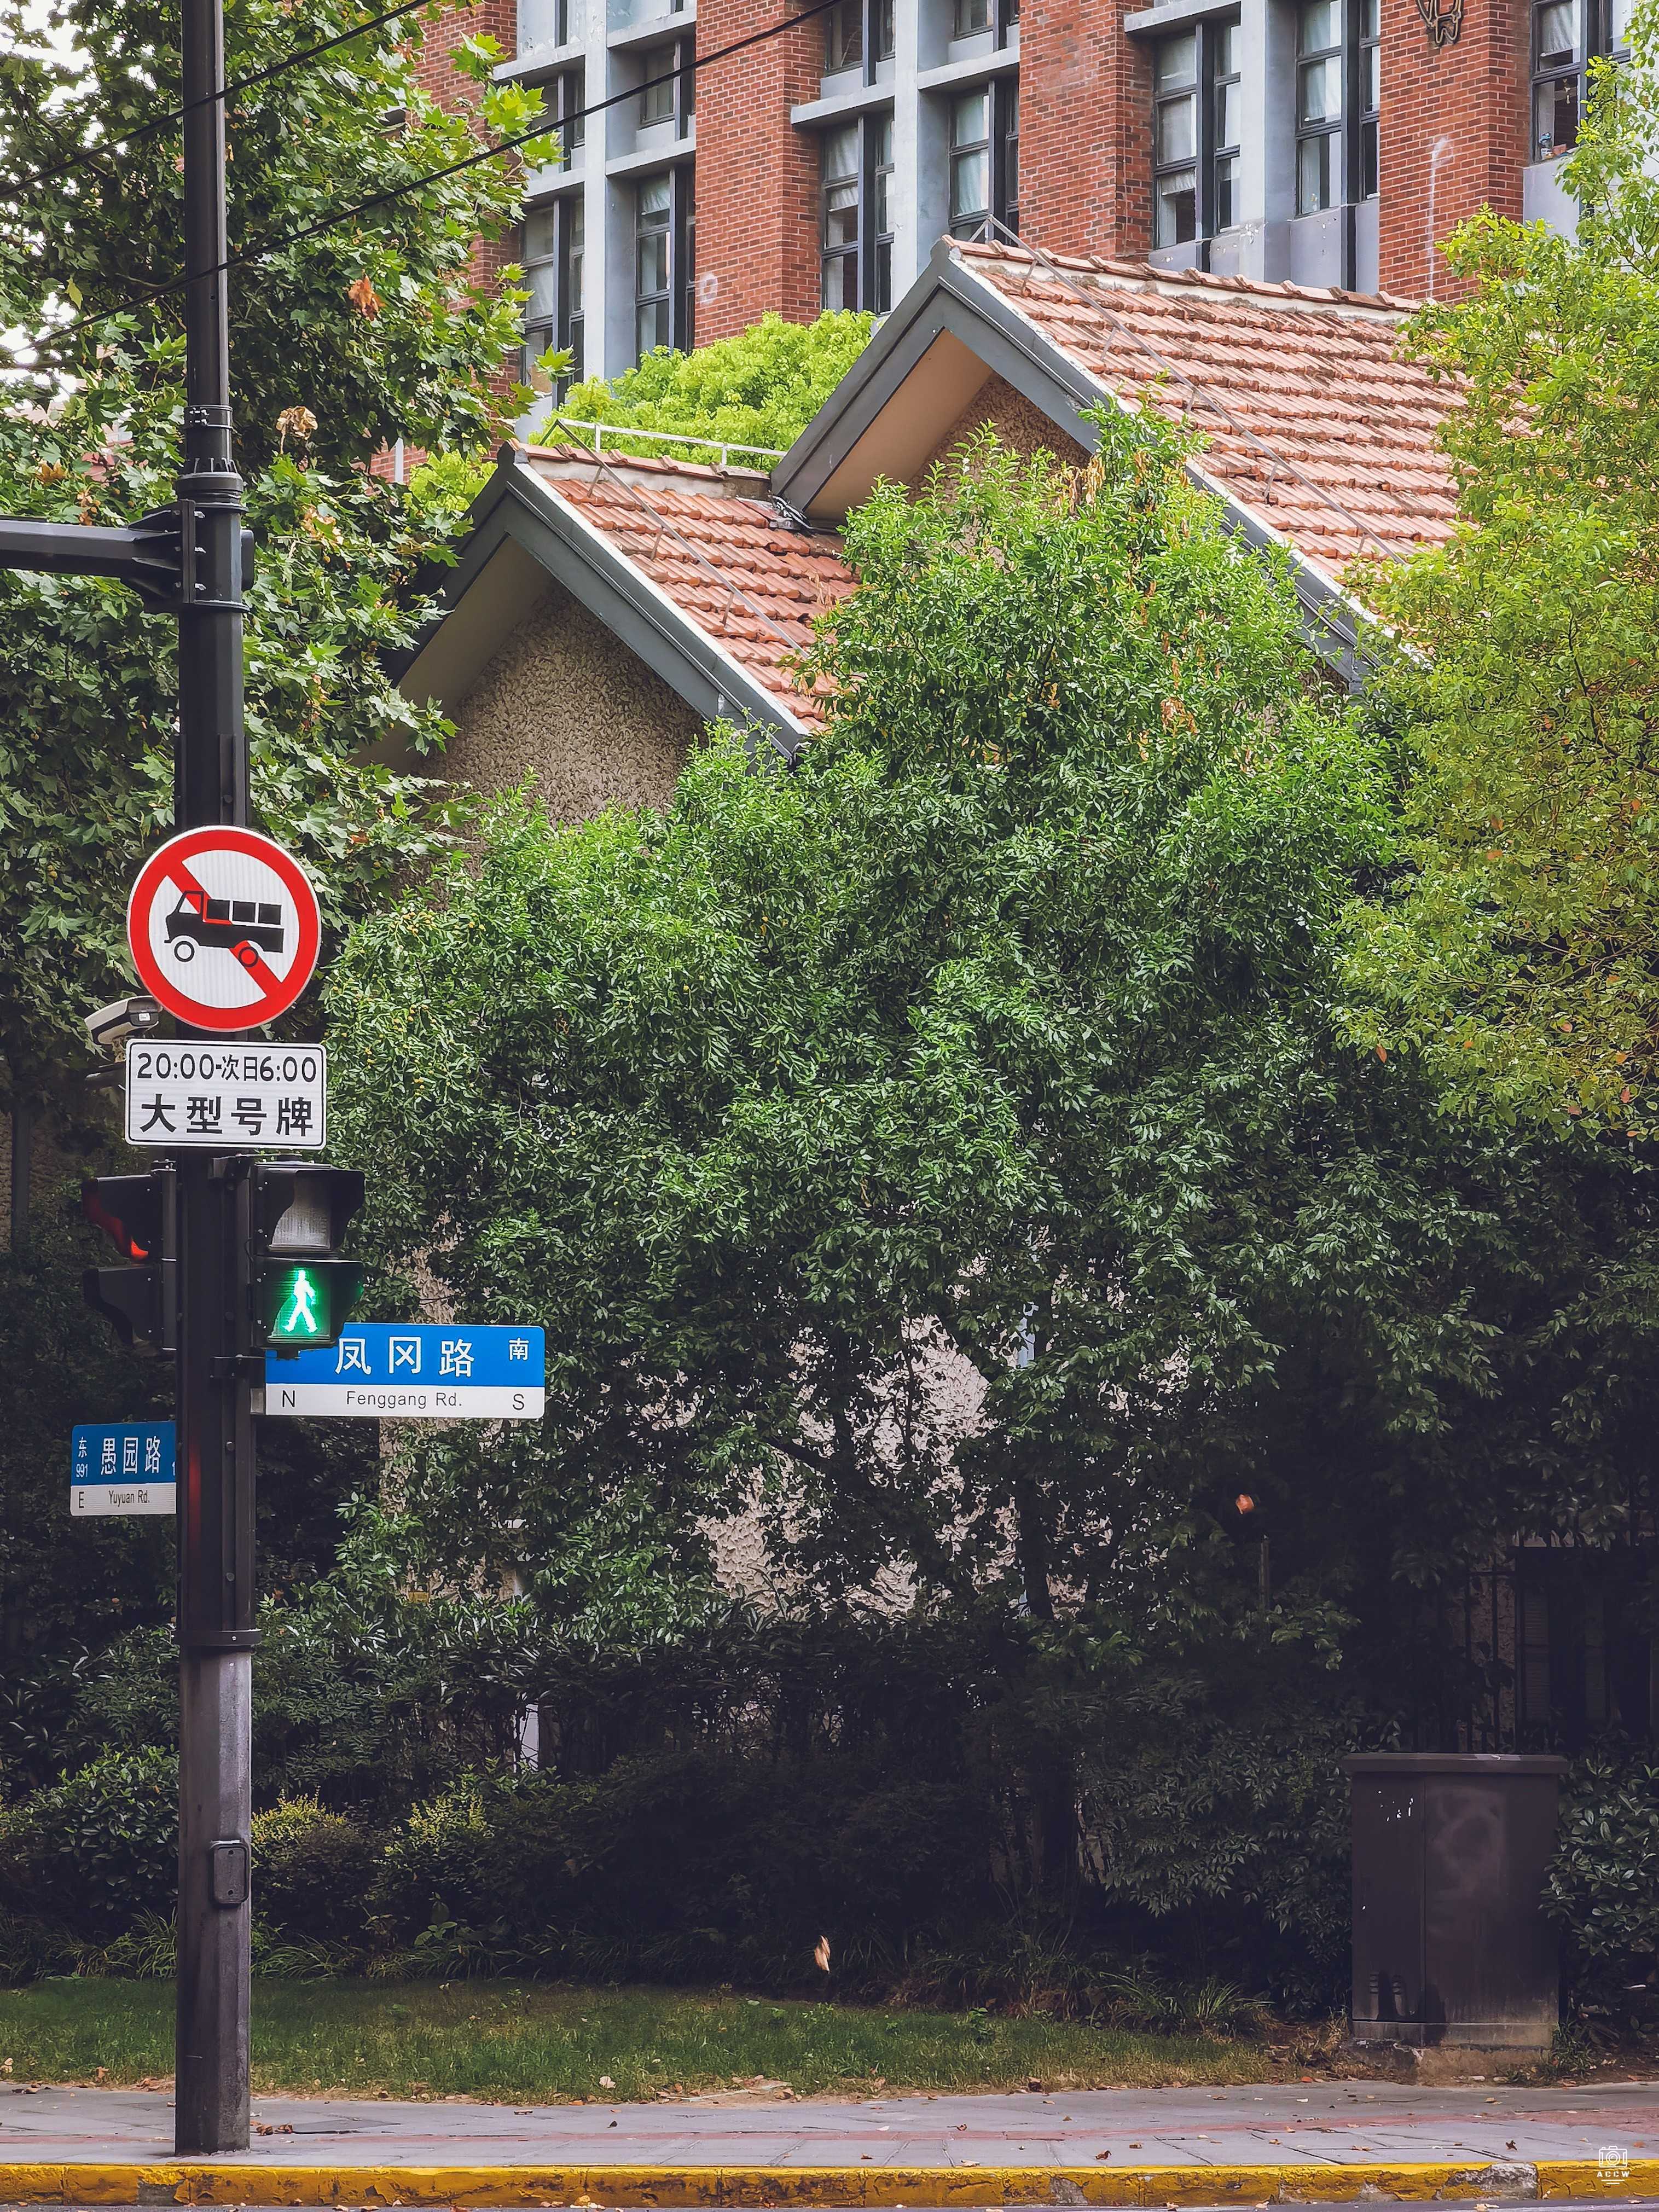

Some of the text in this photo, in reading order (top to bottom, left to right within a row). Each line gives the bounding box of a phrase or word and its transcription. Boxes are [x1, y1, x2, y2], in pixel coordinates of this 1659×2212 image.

[140, 1094, 314, 1137] 大型号牌
[334, 1336, 475, 1377] 凤冈路
[508, 1338, 529, 1361] 南
[281, 1390, 296, 1408] N
[347, 1391, 462, 1409] Fenggang Rd.
[512, 1394, 525, 1410] S
[78, 1436, 88, 1458] 东
[101, 1436, 161, 1475] 愚园路
[79, 1491, 84, 1508] E
[109, 1490, 150, 1507] Yuyuan Rd.
